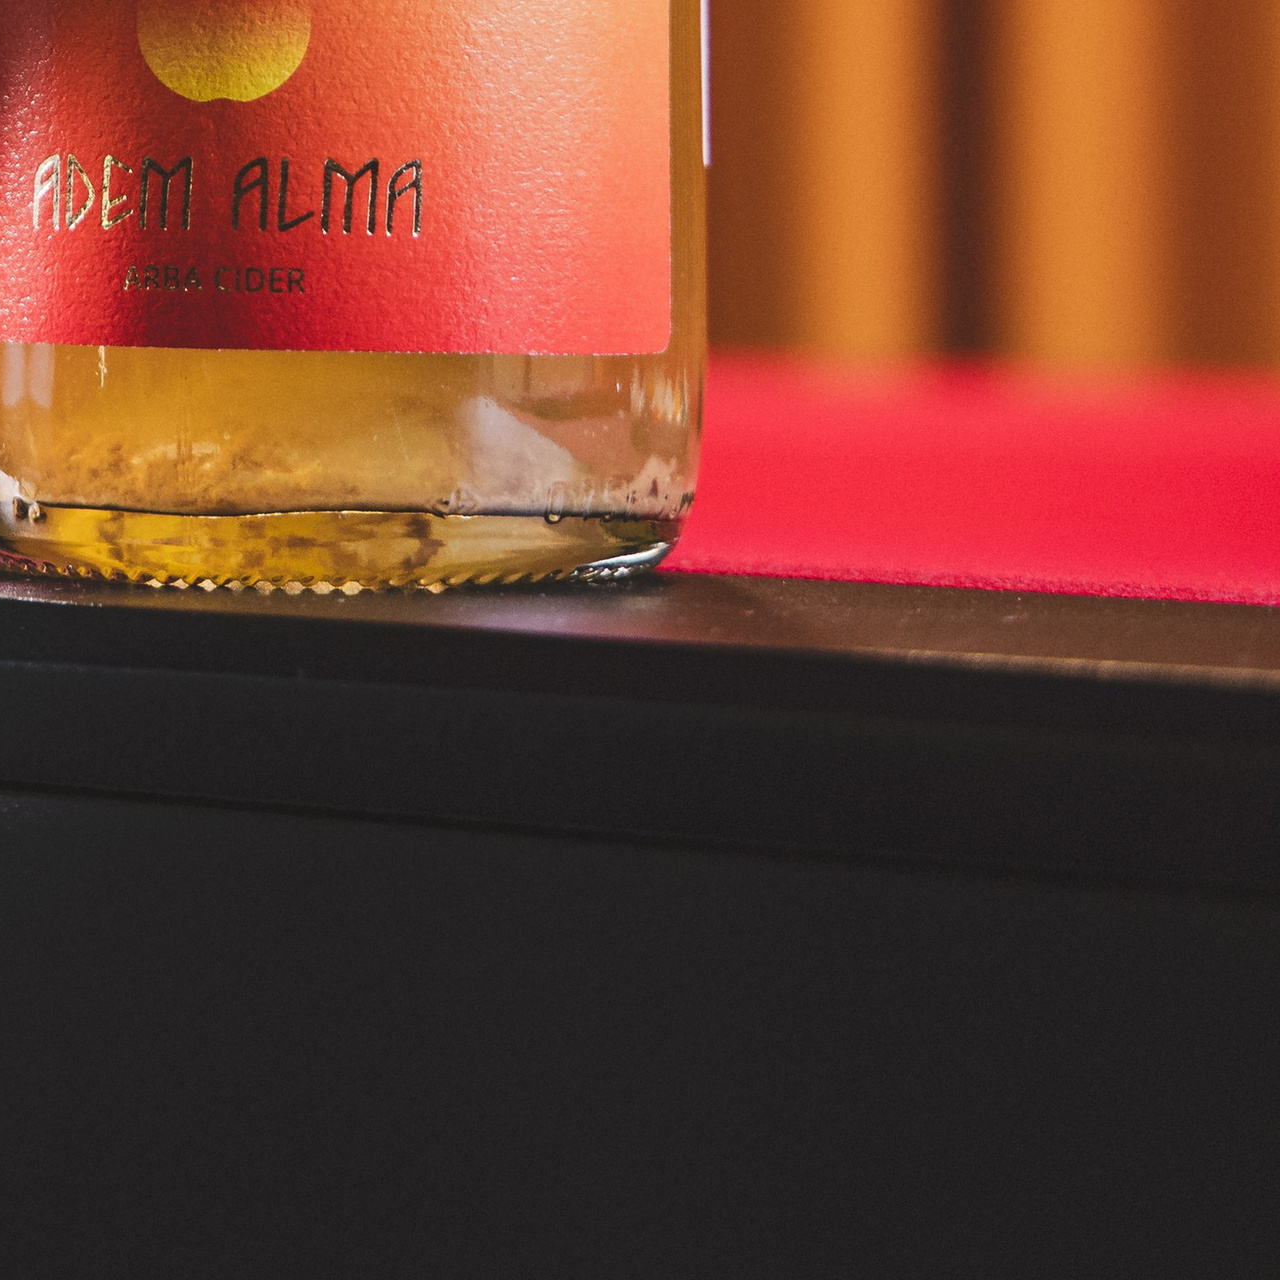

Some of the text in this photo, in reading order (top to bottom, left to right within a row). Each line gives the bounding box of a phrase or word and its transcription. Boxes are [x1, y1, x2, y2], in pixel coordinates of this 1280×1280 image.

[32, 153, 421, 238] ADEM ALMA
[123, 265, 306, 294] ARBA CIDER
